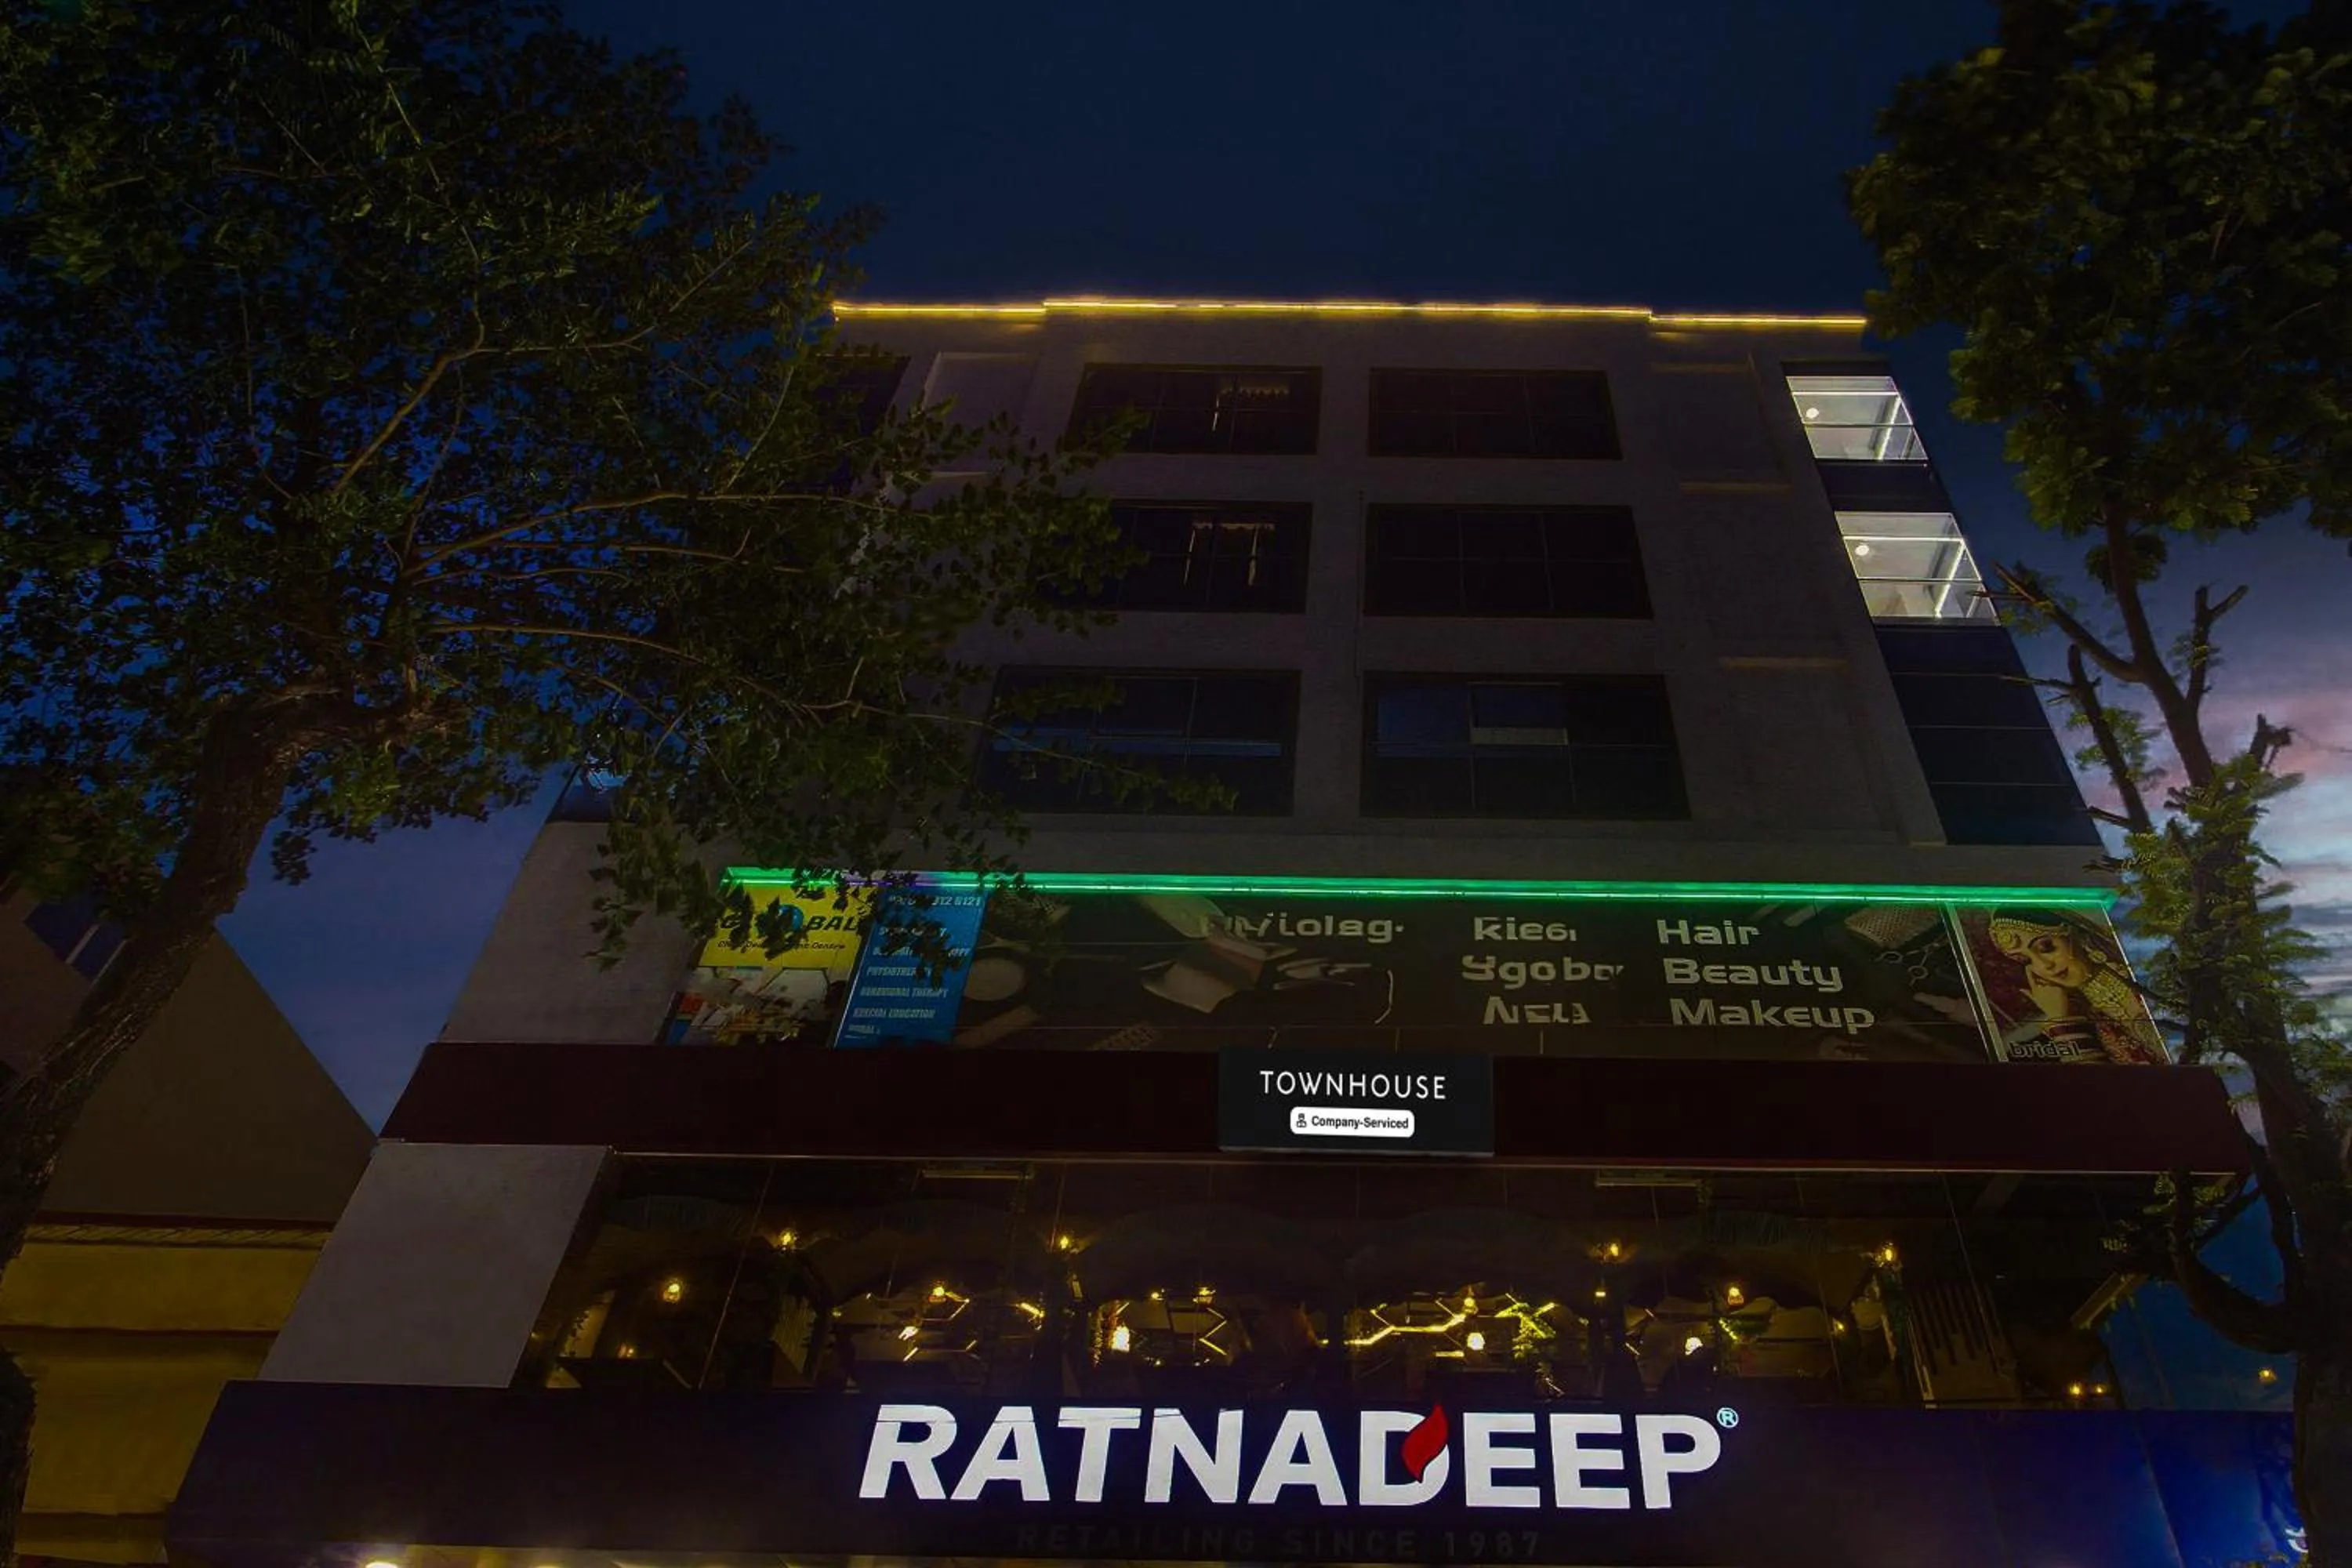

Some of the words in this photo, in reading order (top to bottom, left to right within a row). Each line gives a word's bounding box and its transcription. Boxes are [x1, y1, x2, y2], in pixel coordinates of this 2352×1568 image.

[1656, 919, 1761, 946] Hair
[1662, 957, 1843, 993] Beauty
[1669, 998, 1875, 1035] Makeup
[1259, 1070, 1446, 1100] TOWNHOUSE
[1312, 1116, 1409, 1130] Company-Serviced
[858, 1403, 1722, 1510] RATNADEEP
[1019, 1524, 1255, 1555] RETAILING
[1283, 1528, 1418, 1556] SINCE
[1443, 1530, 1540, 1558] 1987
